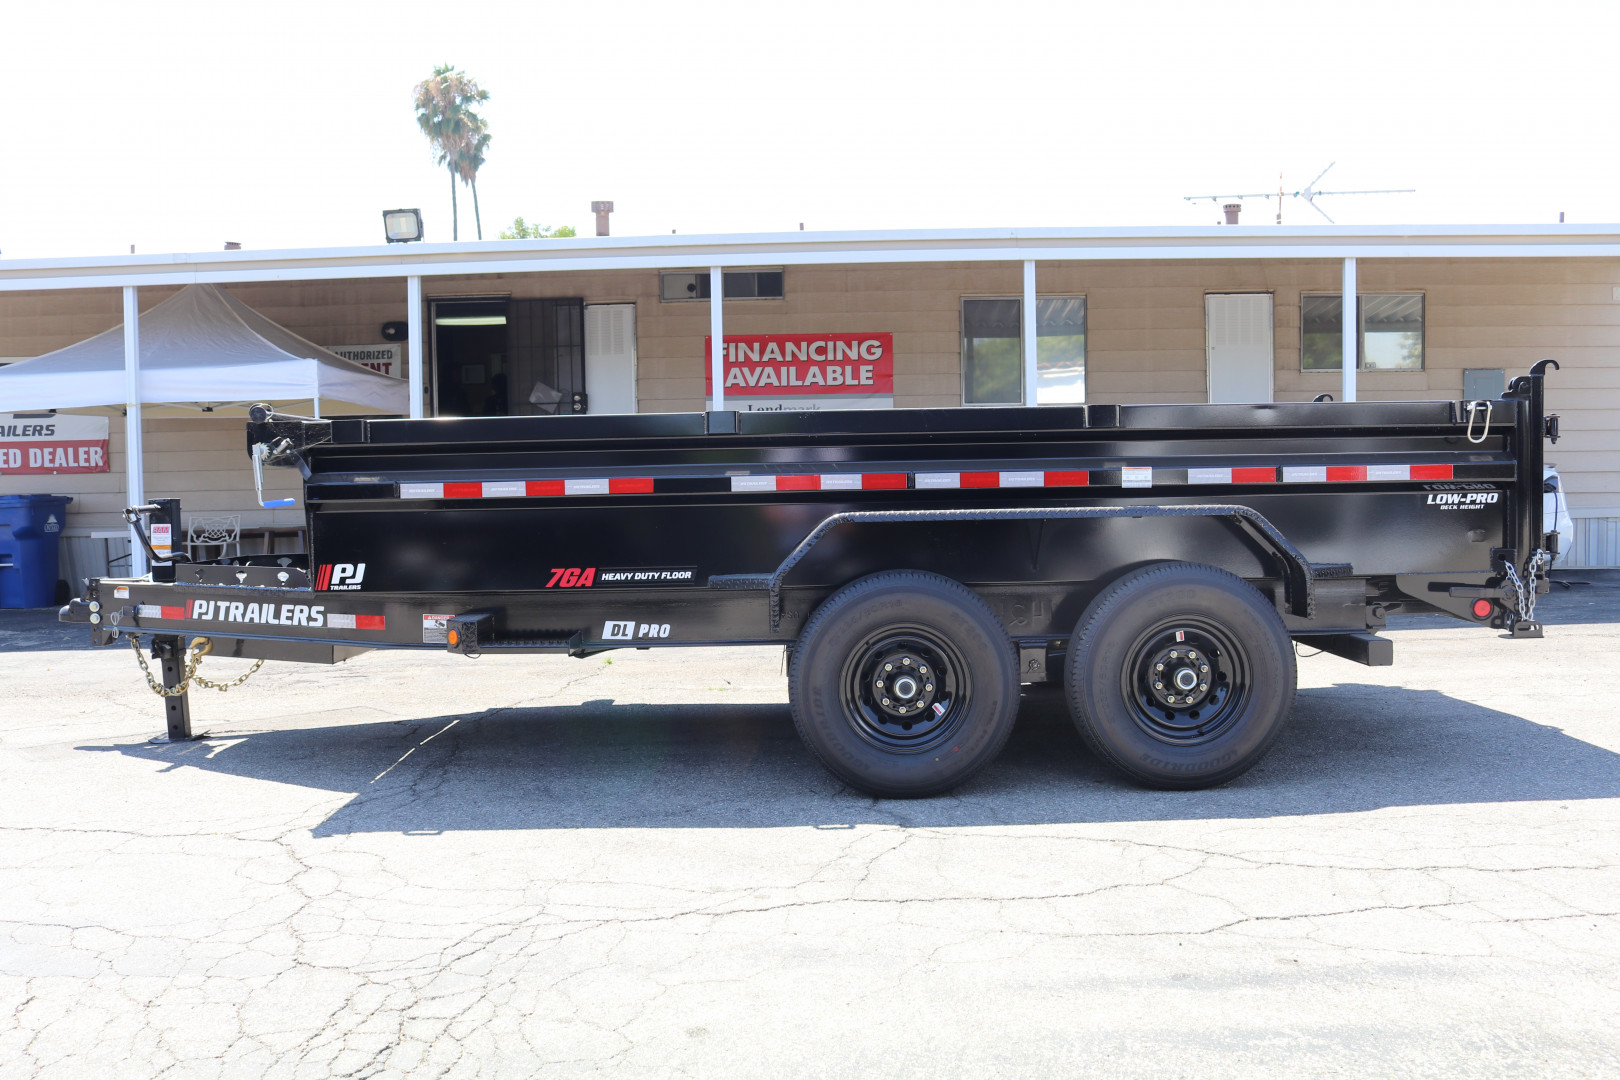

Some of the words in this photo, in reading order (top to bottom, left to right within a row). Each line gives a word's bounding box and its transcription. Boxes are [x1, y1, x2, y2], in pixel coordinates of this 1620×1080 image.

[724, 365, 874, 387] AVAILABLE
[28, 446, 103, 468] DEALER
[1427, 493, 1499, 505] LOW-PRO
[331, 563, 366, 584] PJ
[545, 567, 596, 587] 7GA
[601, 572, 633, 581] HEAVY
[634, 572, 660, 580] DUTY
[661, 571, 692, 579] FLOOR
[610, 623, 629, 637] DL
[638, 624, 671, 638] PRO
